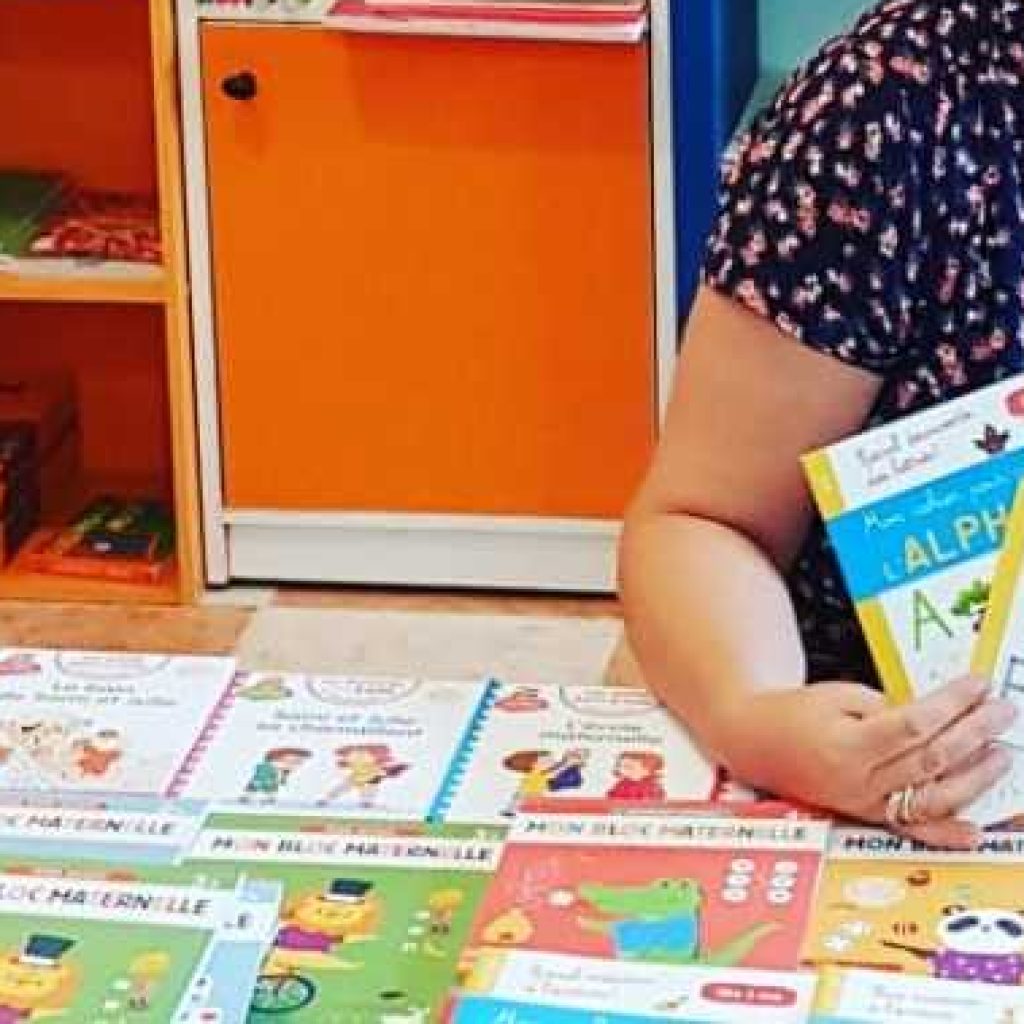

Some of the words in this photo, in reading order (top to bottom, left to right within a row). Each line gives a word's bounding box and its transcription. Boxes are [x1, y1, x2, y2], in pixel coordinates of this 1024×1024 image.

[912, 588, 955, 651] A
[211, 836, 270, 852] MON
[343, 840, 493, 861] MATERNELLE
[844, 835, 902, 852] MON
[48, 887, 212, 915] MATERNELLE
